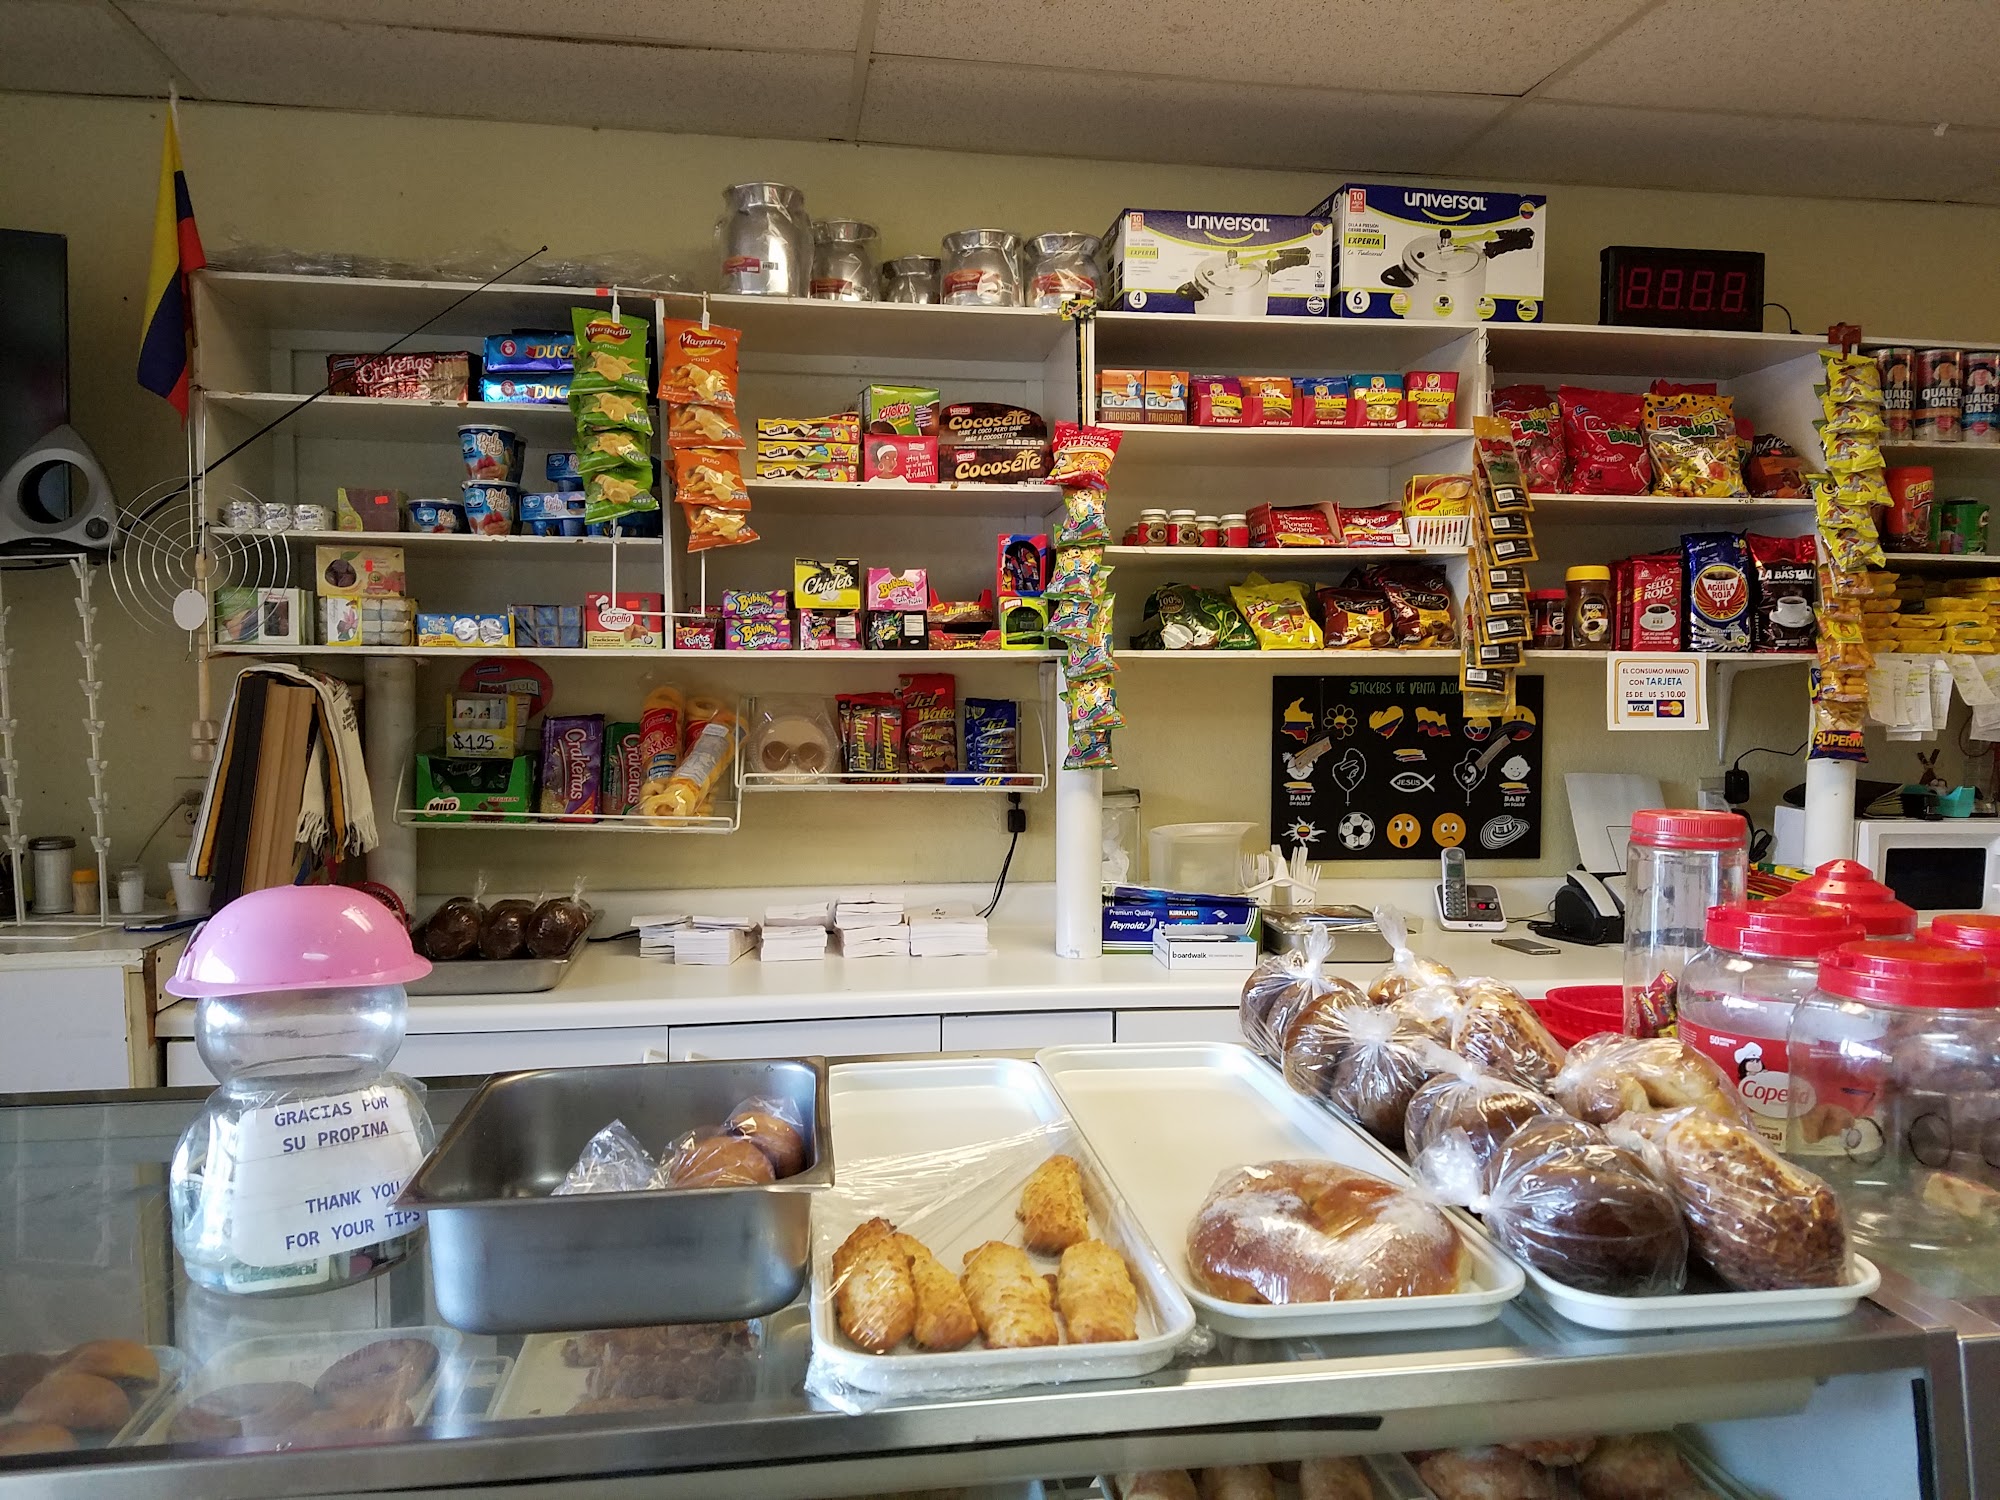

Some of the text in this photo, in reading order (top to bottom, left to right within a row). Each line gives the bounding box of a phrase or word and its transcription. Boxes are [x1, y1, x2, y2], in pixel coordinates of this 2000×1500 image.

[1352, 192, 1363, 201] 10
[1404, 191, 1487, 211] universal
[1131, 215, 1142, 223] 10
[1187, 215, 1270, 232] universal
[1348, 237, 1381, 246] EXPERTA
[1134, 291, 1141, 303] 4
[1353, 292, 1362, 306] 6
[584, 324, 632, 341] Margarita
[679, 332, 727, 348] Margarita
[360, 355, 435, 384] Crakeñas
[1415, 393, 1450, 403] Sancocho
[1884, 389, 1913, 400] UAKE
[1965, 393, 2000, 405] UAKER
[1887, 399, 1911, 410] OATS
[1931, 397, 1958, 407] OATS
[1965, 403, 1994, 413] OATS
[880, 404, 910, 420] CHOKIS
[1104, 411, 1141, 422] TRIGUISAR
[1148, 412, 1183, 423] TRIGUISAR
[1660, 411, 1727, 428] BON BON
[1679, 425, 1715, 437] BUM
[1608, 430, 1643, 446] BUM
[1753, 436, 1791, 451] offee
[1370, 534, 1392, 542] Sopera
[804, 575, 854, 595] Chiclets
[1645, 579, 1674, 592] SELLO
[1644, 586, 1673, 600] ROJO
[737, 592, 773, 610] Bubbaloo
[1159, 596, 1182, 607] 100%
[945, 604, 980, 616] Jumbo
[600, 613, 631, 624] Copelia
[740, 622, 778, 642] Bubbaloo
[954, 640, 976, 649] Jumbo
[1646, 677, 1682, 686] TARJETA
[1396, 682, 1405, 694] DE
[1410, 682, 1436, 694] VENTA
[1440, 682, 1460, 694] AQU
[1666, 690, 1686, 698] 10.00
[908, 694, 938, 708] Jet
[922, 732, 944, 740] Wafer
[880, 718, 898, 770] Jumbo
[428, 802, 457, 812] MILO
[1134, 910, 1154, 918] Quality
[1110, 921, 1147, 932] Reynolds
[1710, 1035, 1720, 1045] 50
[1742, 1080, 1810, 1104] Copea
[274, 1096, 389, 1127] GRACIAS POR
[282, 1120, 389, 1152] SU PROPINA
[305, 1181, 400, 1214] THANK YOU
[286, 1210, 420, 1250] FOR YOUR TIPS
